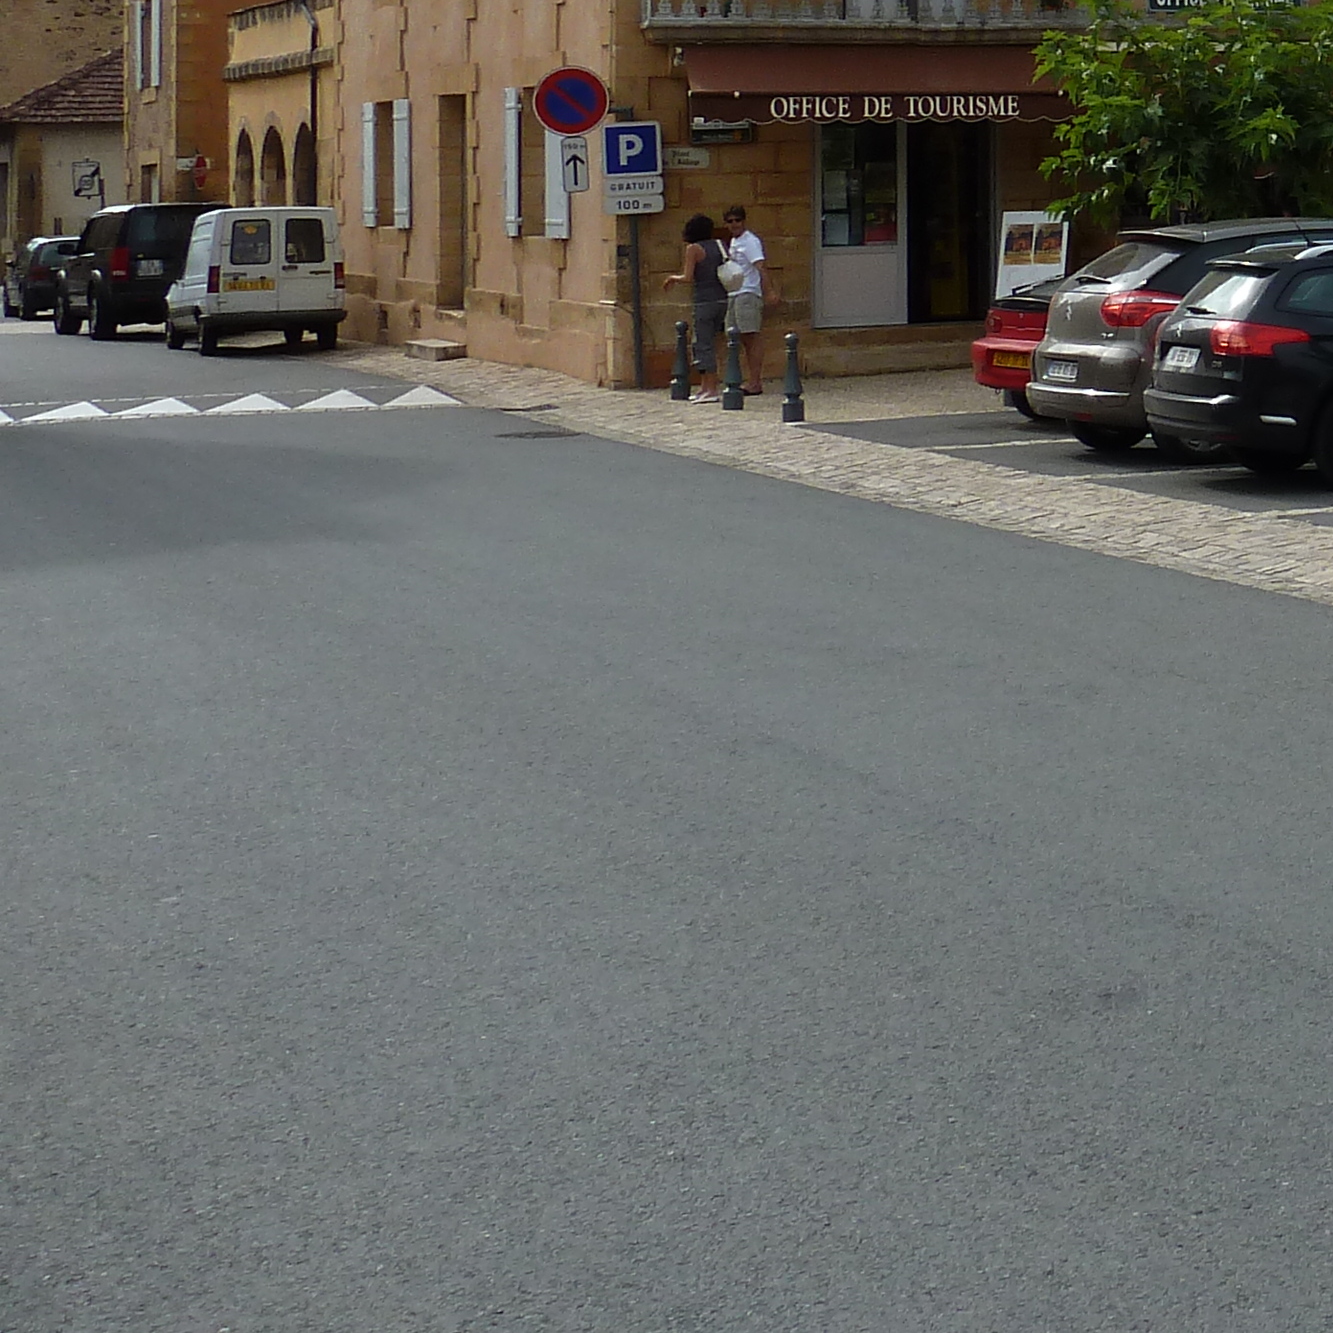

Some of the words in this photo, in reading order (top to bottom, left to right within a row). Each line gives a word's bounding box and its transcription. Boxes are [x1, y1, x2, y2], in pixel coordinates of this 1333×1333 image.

[770, 96, 850, 118] OFFICE
[863, 96, 893, 117] DE
[904, 95, 1020, 117] TOURISME
[618, 134, 644, 166] P
[609, 181, 656, 192] GRATUIT
[617, 200, 640, 211] 100
